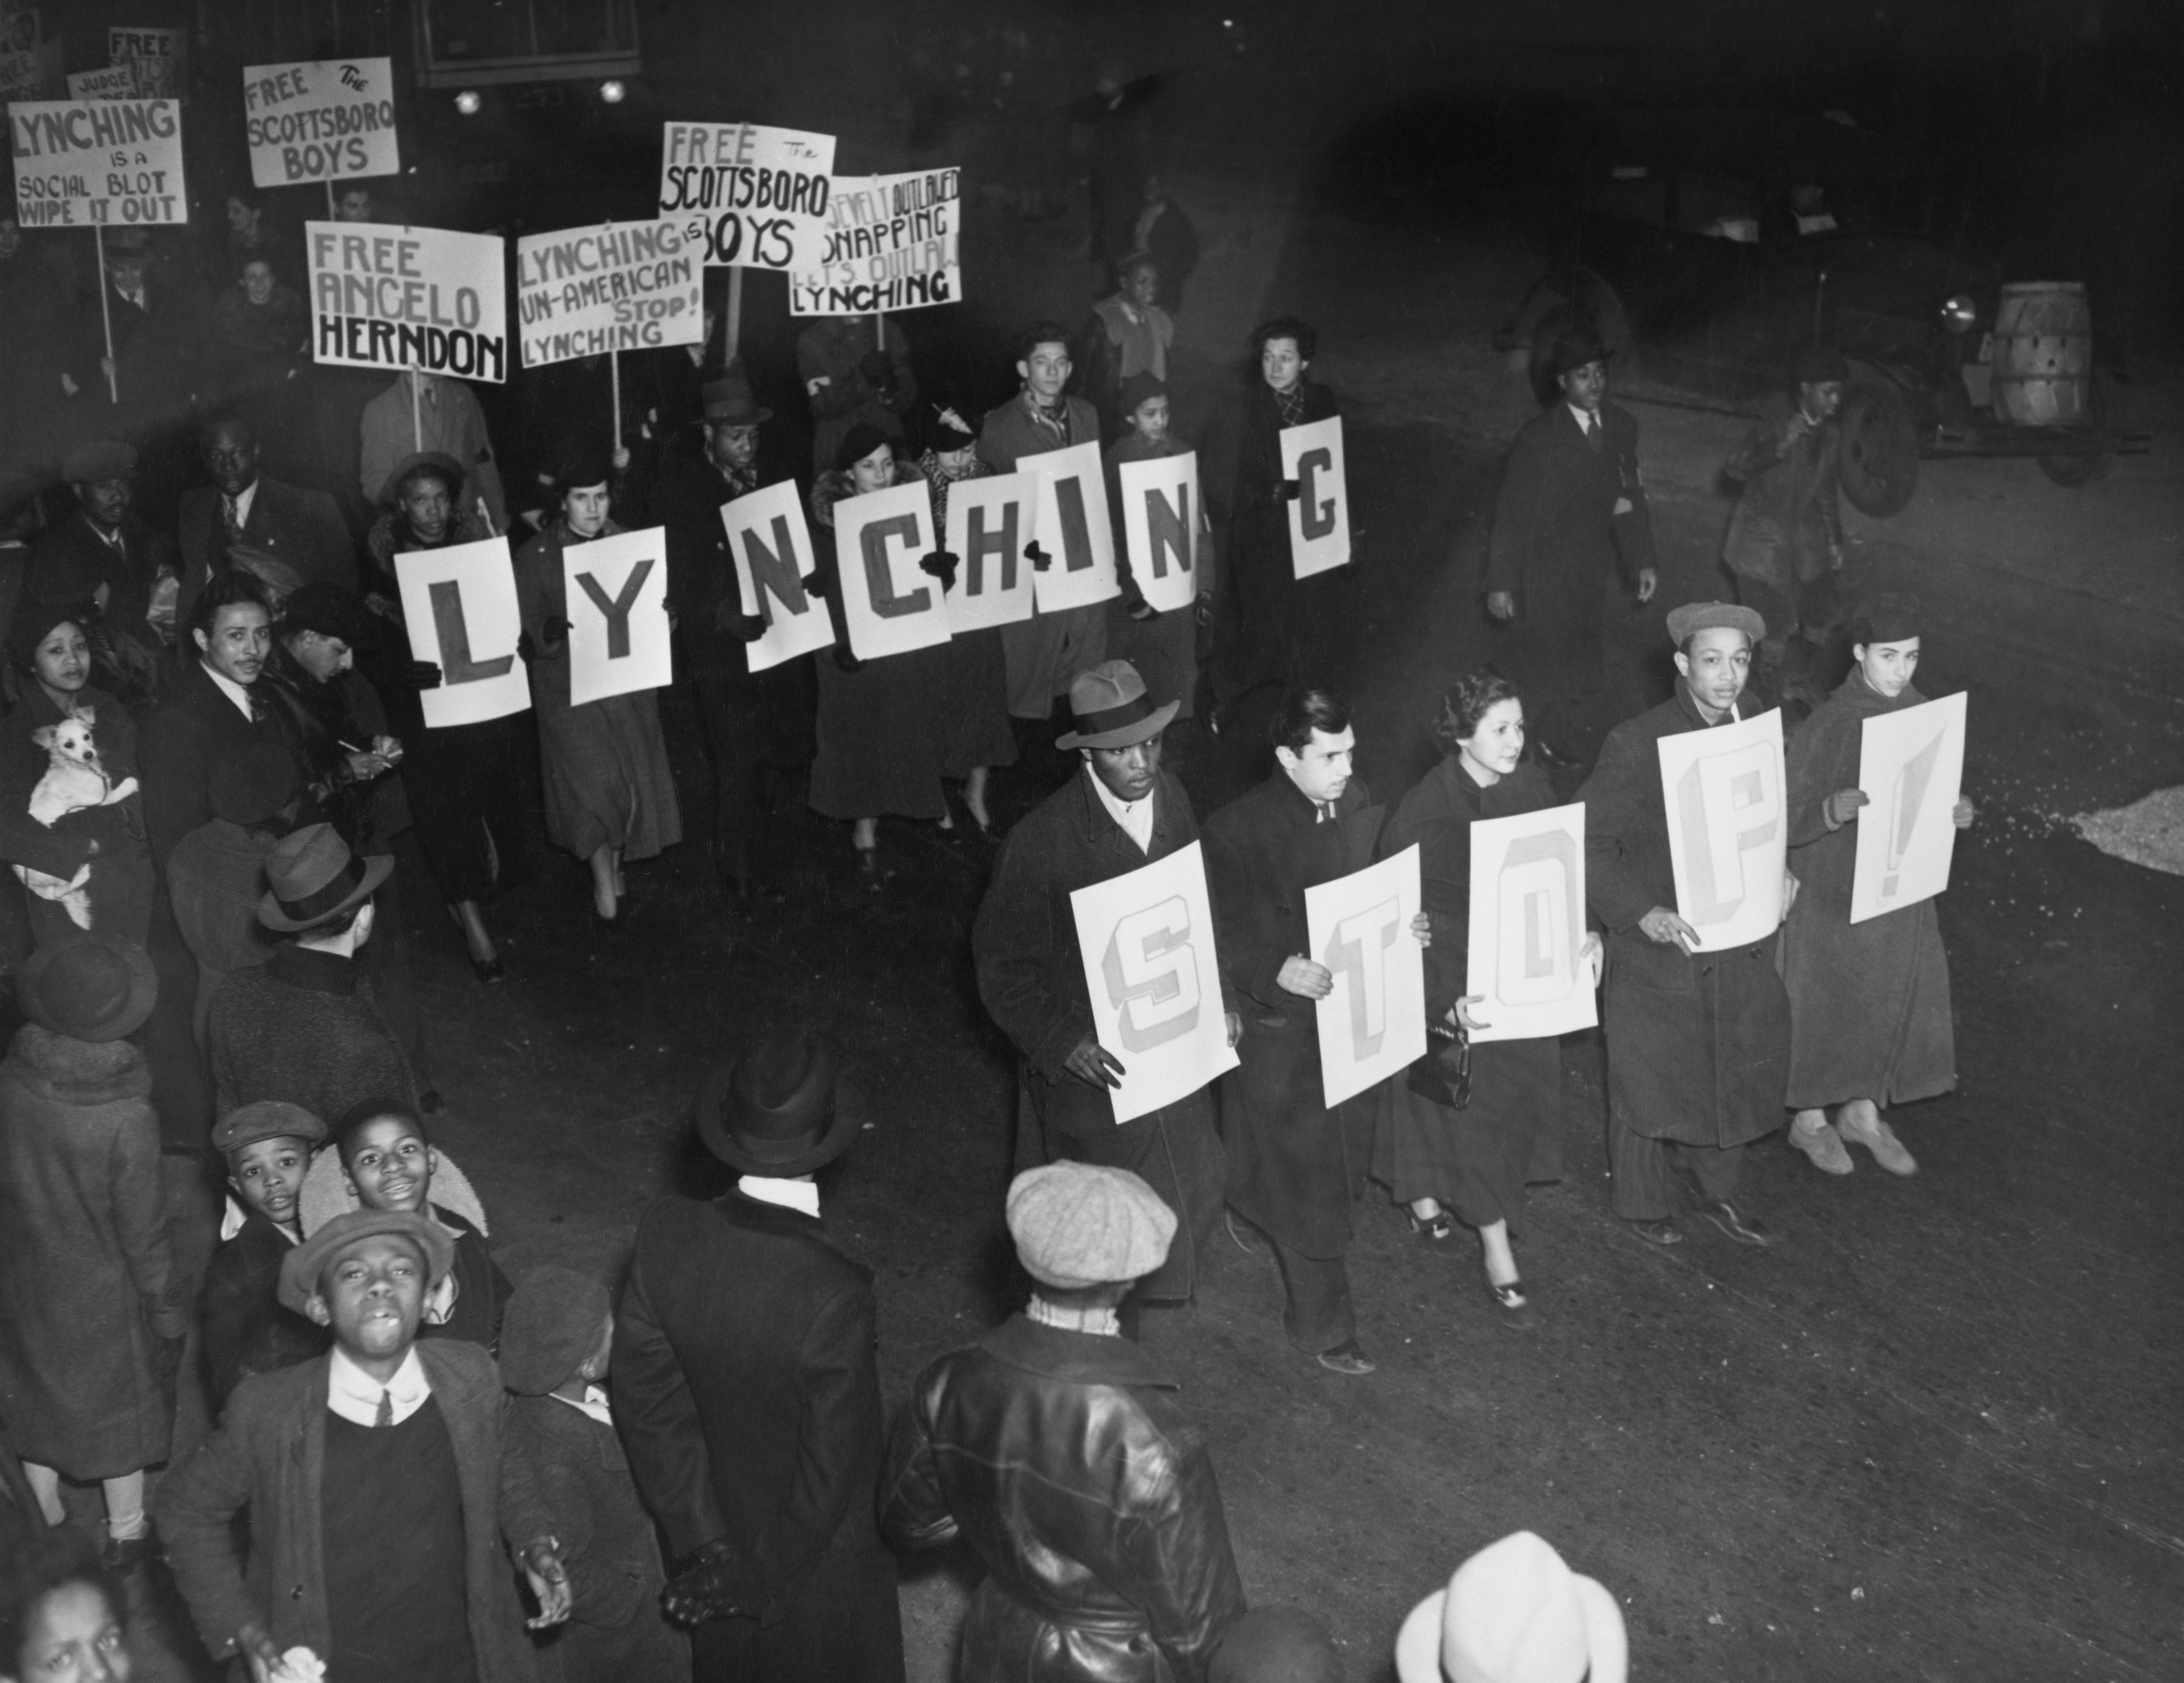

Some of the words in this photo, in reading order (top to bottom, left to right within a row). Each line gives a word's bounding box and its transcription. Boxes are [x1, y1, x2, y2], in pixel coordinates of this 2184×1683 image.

[111, 32, 171, 57] FREE
[78, 72, 129, 93] JUDGE
[245, 68, 309, 111] FREE
[9, 100, 176, 157] LYNCHING
[248, 100, 394, 147] SCOTTSBORO
[110, 151, 128, 167] IS
[135, 152, 148, 165] A
[284, 137, 368, 180] BOYS
[671, 127, 757, 165] FREE
[19, 175, 91, 199] SOCIAL
[106, 171, 166, 197] BLOT
[660, 165, 829, 217] SCOTTSBORO
[19, 199, 74, 225] WIPE
[89, 199, 110, 223] IT
[122, 196, 176, 223] OUT
[314, 233, 421, 277] FREE
[518, 222, 681, 288] LYNCHING
[682, 222, 703, 243] IS
[822, 205, 947, 263] DNAPPING
[869, 236, 959, 282] OUTLAW
[317, 272, 480, 329] ANGELO
[521, 256, 691, 324] UN-AMERICAN
[614, 287, 699, 323] STOP!
[793, 270, 950, 312] LYNCHING
[320, 314, 504, 381] HERNDON
[525, 321, 663, 364] LYNCHING
